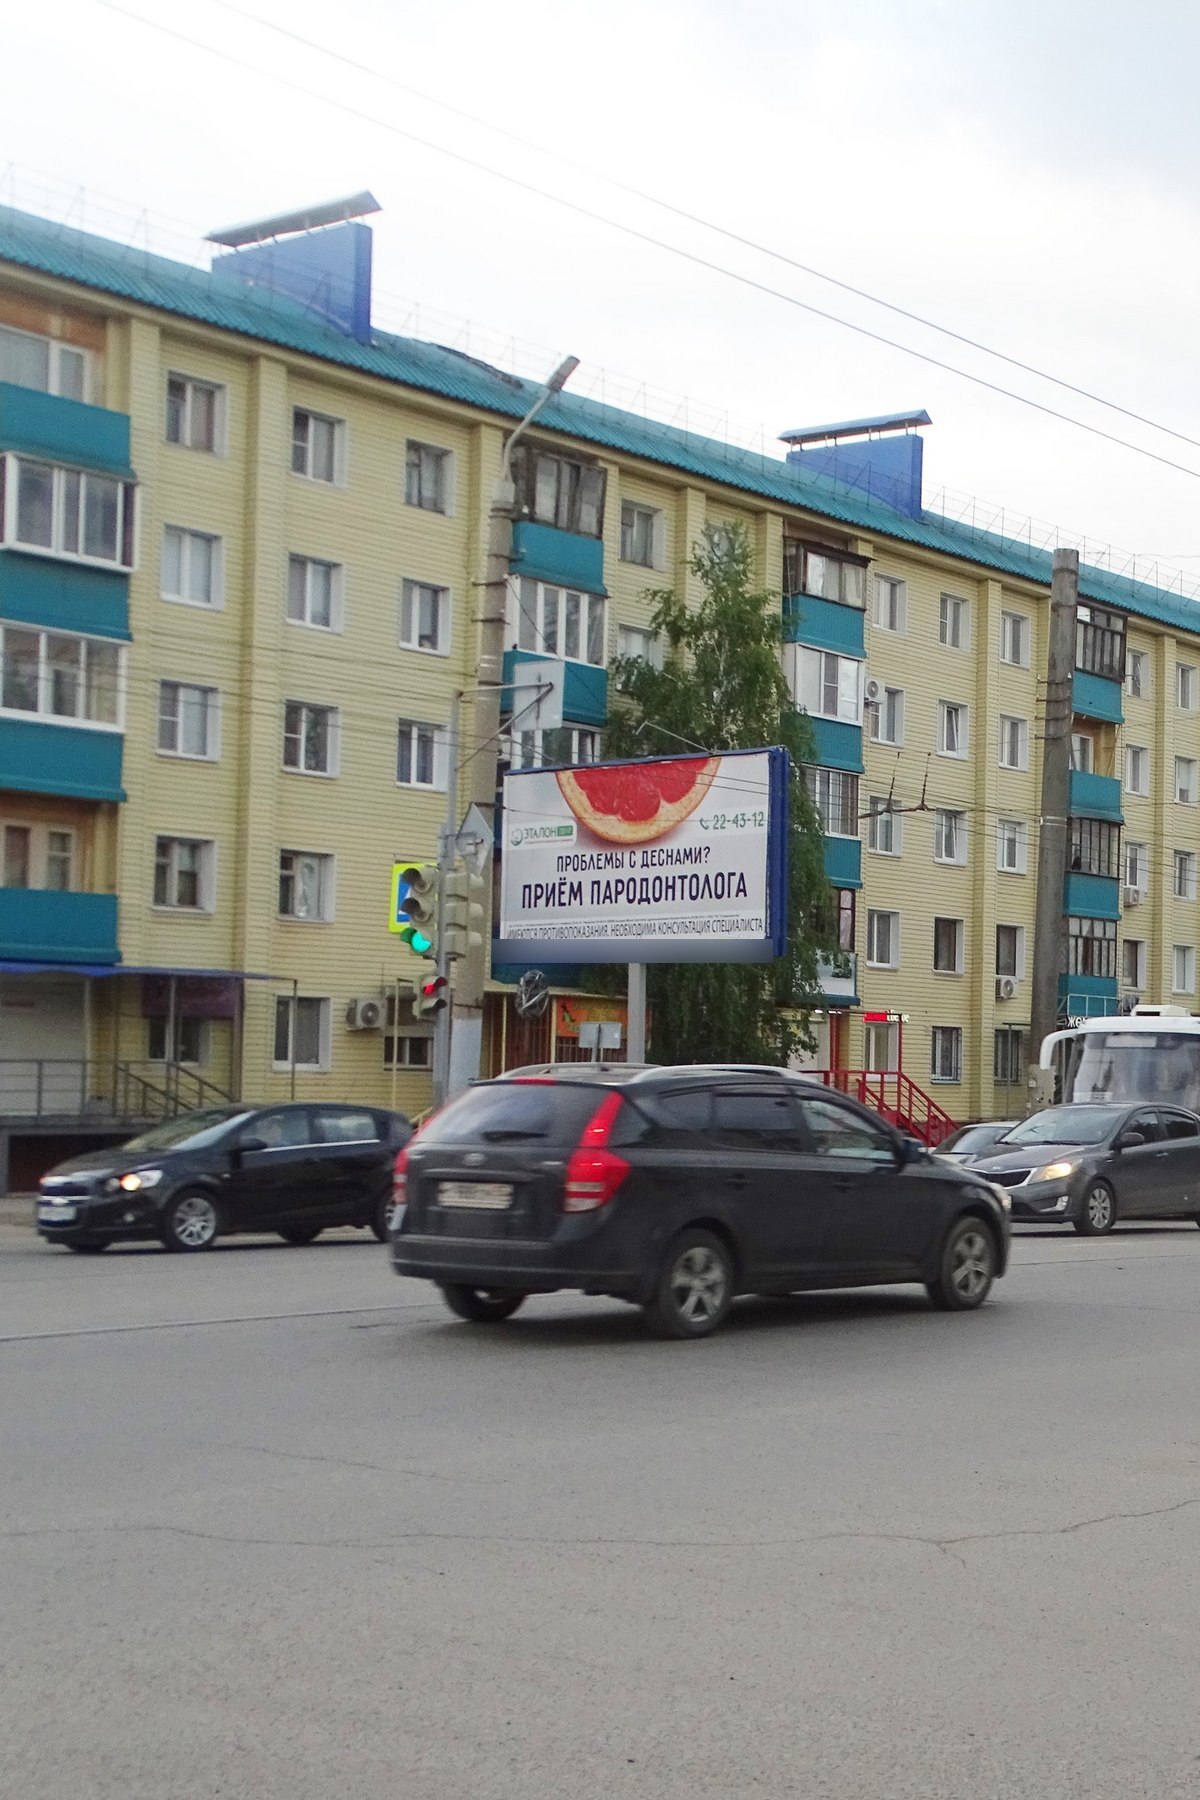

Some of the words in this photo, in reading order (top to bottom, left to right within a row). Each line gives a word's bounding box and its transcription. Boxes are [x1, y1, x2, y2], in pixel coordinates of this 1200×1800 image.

[712, 811, 765, 829] 22-43-12
[524, 827, 556, 839] ЭТАЛОН
[556, 851, 625, 872] ПРОБЛЕМЫ
[628, 851, 636, 868] С
[640, 847, 711, 869] ДЕСНАМИ?
[521, 877, 583, 909] ПРИЁМ
[590, 871, 748, 905] ПАРОДОНТОЛОГА
[610, 922, 656, 938] НЕОБХОДИМА
[658, 920, 710, 936] КОНСУЛЬТАЦИЯ
[712, 918, 763, 934] СПЕЦИАЛИСТА
